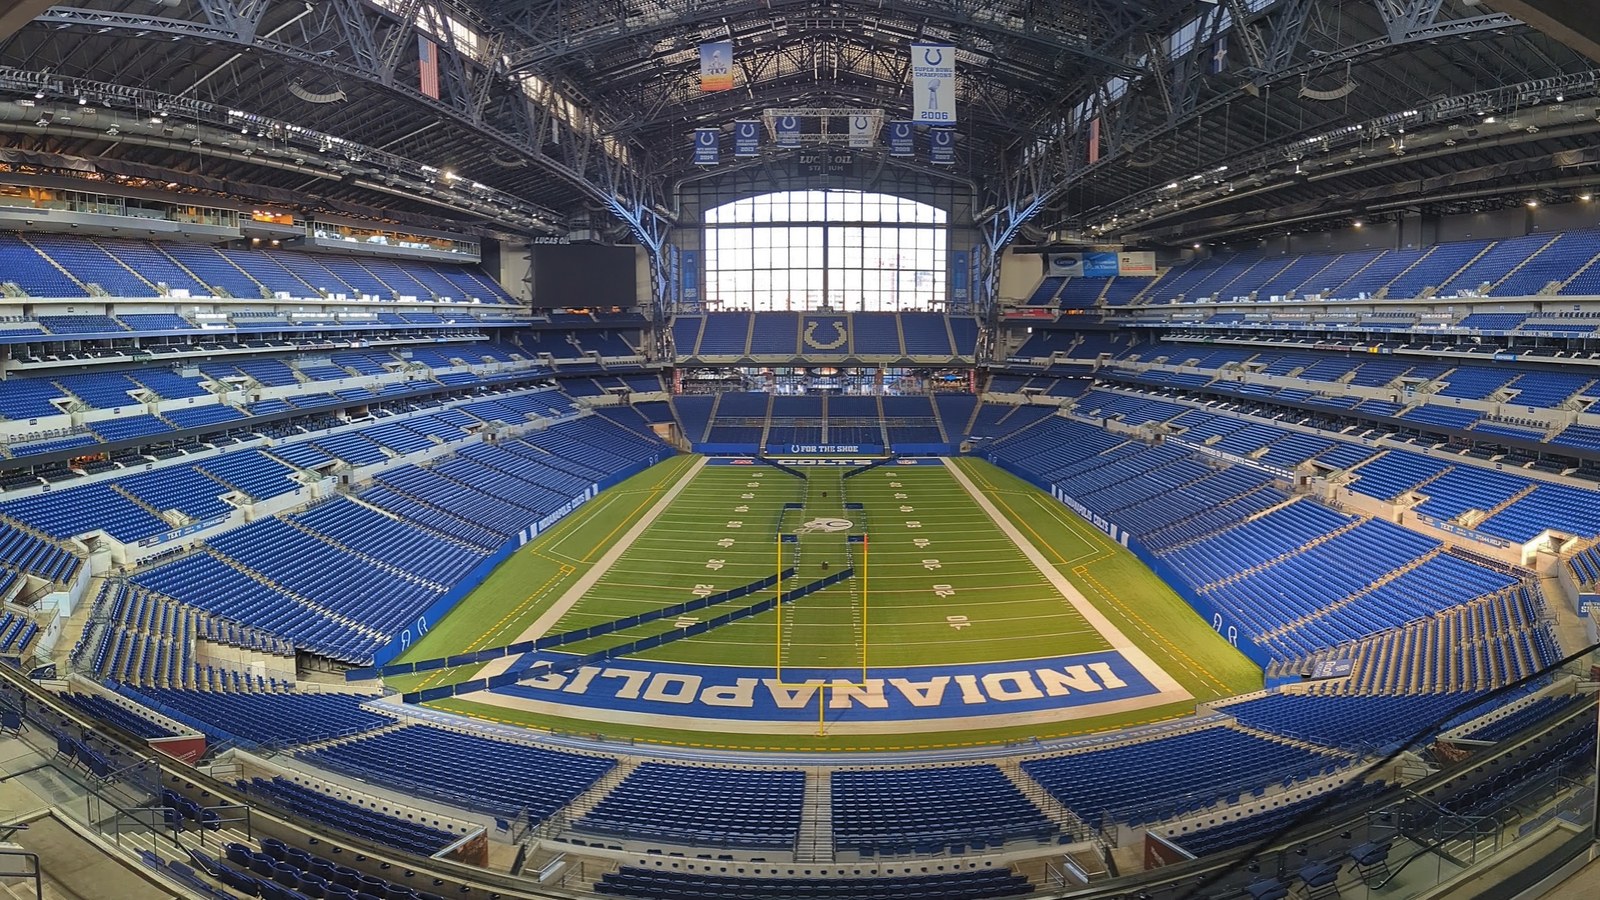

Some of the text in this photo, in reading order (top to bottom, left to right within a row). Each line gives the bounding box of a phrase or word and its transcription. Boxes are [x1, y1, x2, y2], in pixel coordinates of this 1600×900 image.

[921, 111, 948, 120] 2006
[800, 155, 852, 164] LUCS OIL
[534, 236, 571, 245] LUCAS OIL
[800, 445, 859, 453] FOR THE SHOE
[1441, 522, 1454, 532] TEXT
[167, 530, 181, 539] TEXT
[946, 615, 971, 627] 10
